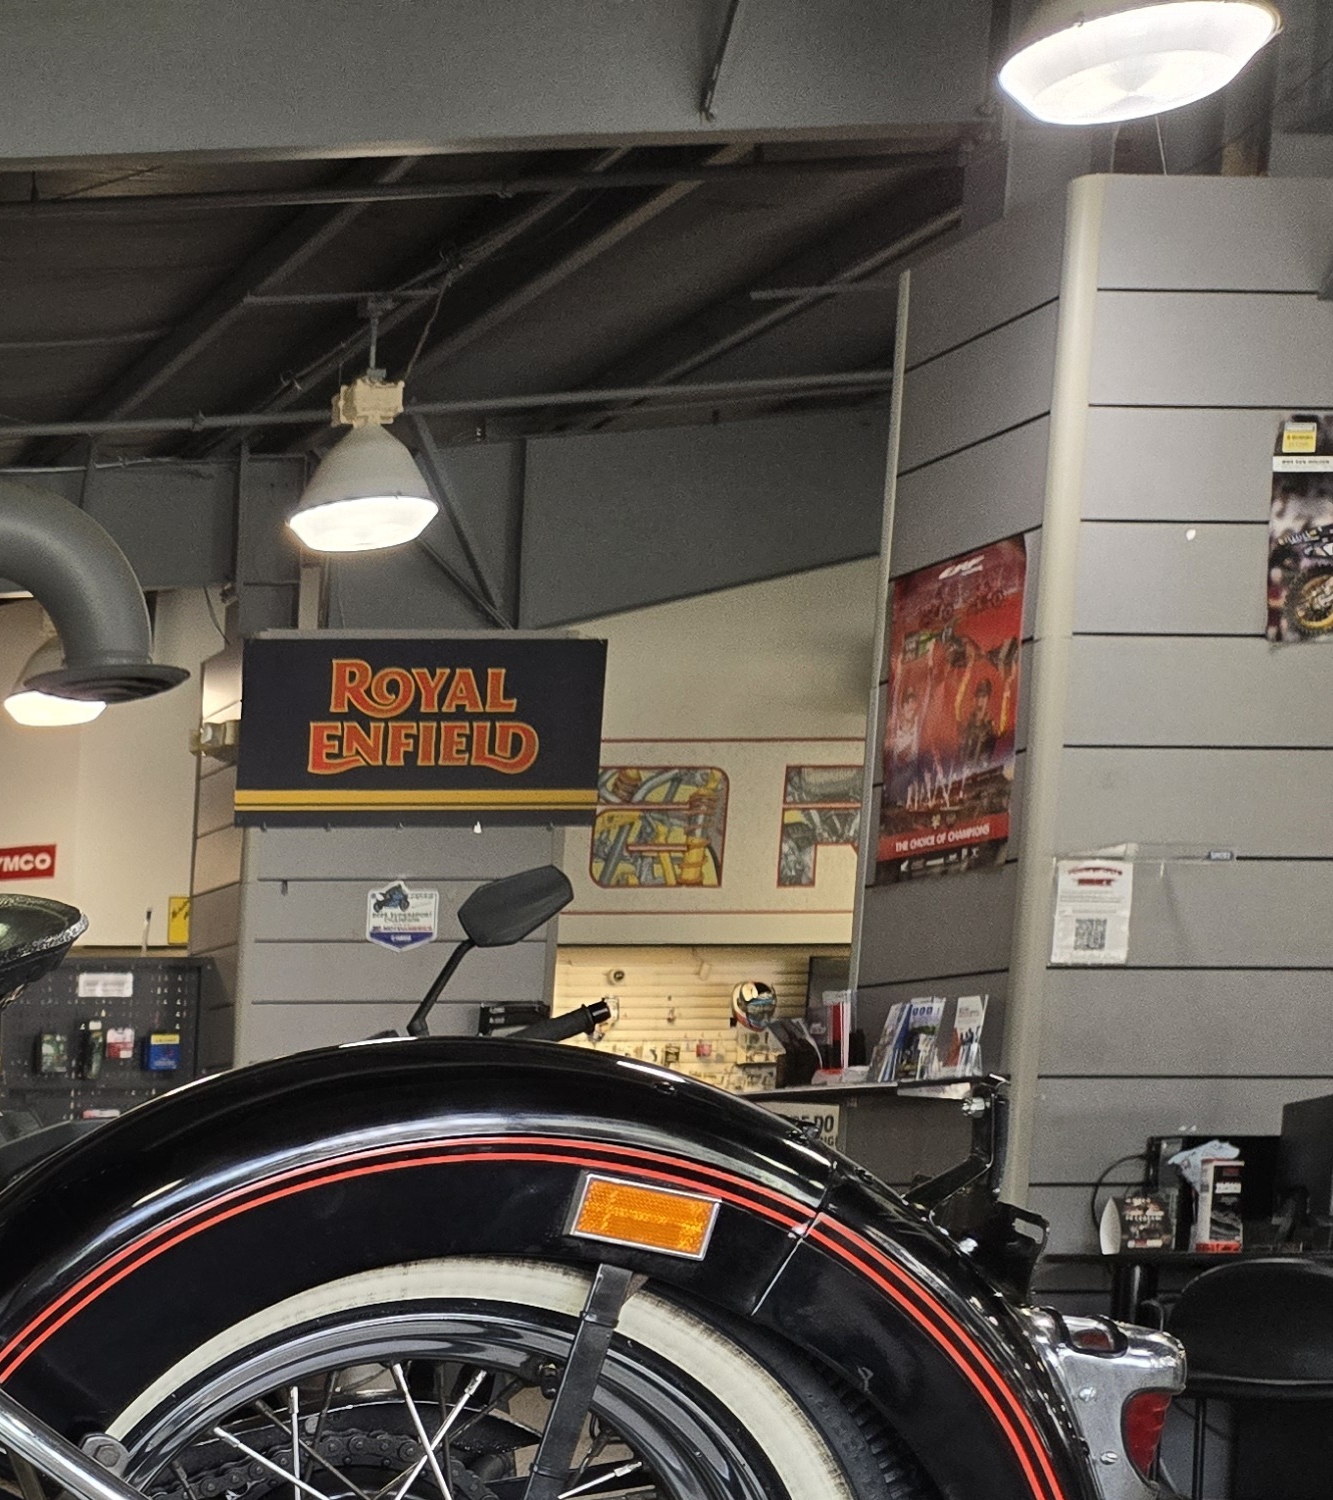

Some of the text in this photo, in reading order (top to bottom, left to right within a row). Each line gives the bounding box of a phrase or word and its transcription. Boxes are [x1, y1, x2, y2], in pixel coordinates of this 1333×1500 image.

[329, 658, 518, 718] ROYAL
[307, 720, 539, 775] ENFIELD
[896, 823, 990, 852] THE CHOICE OF CHAMPIONS
